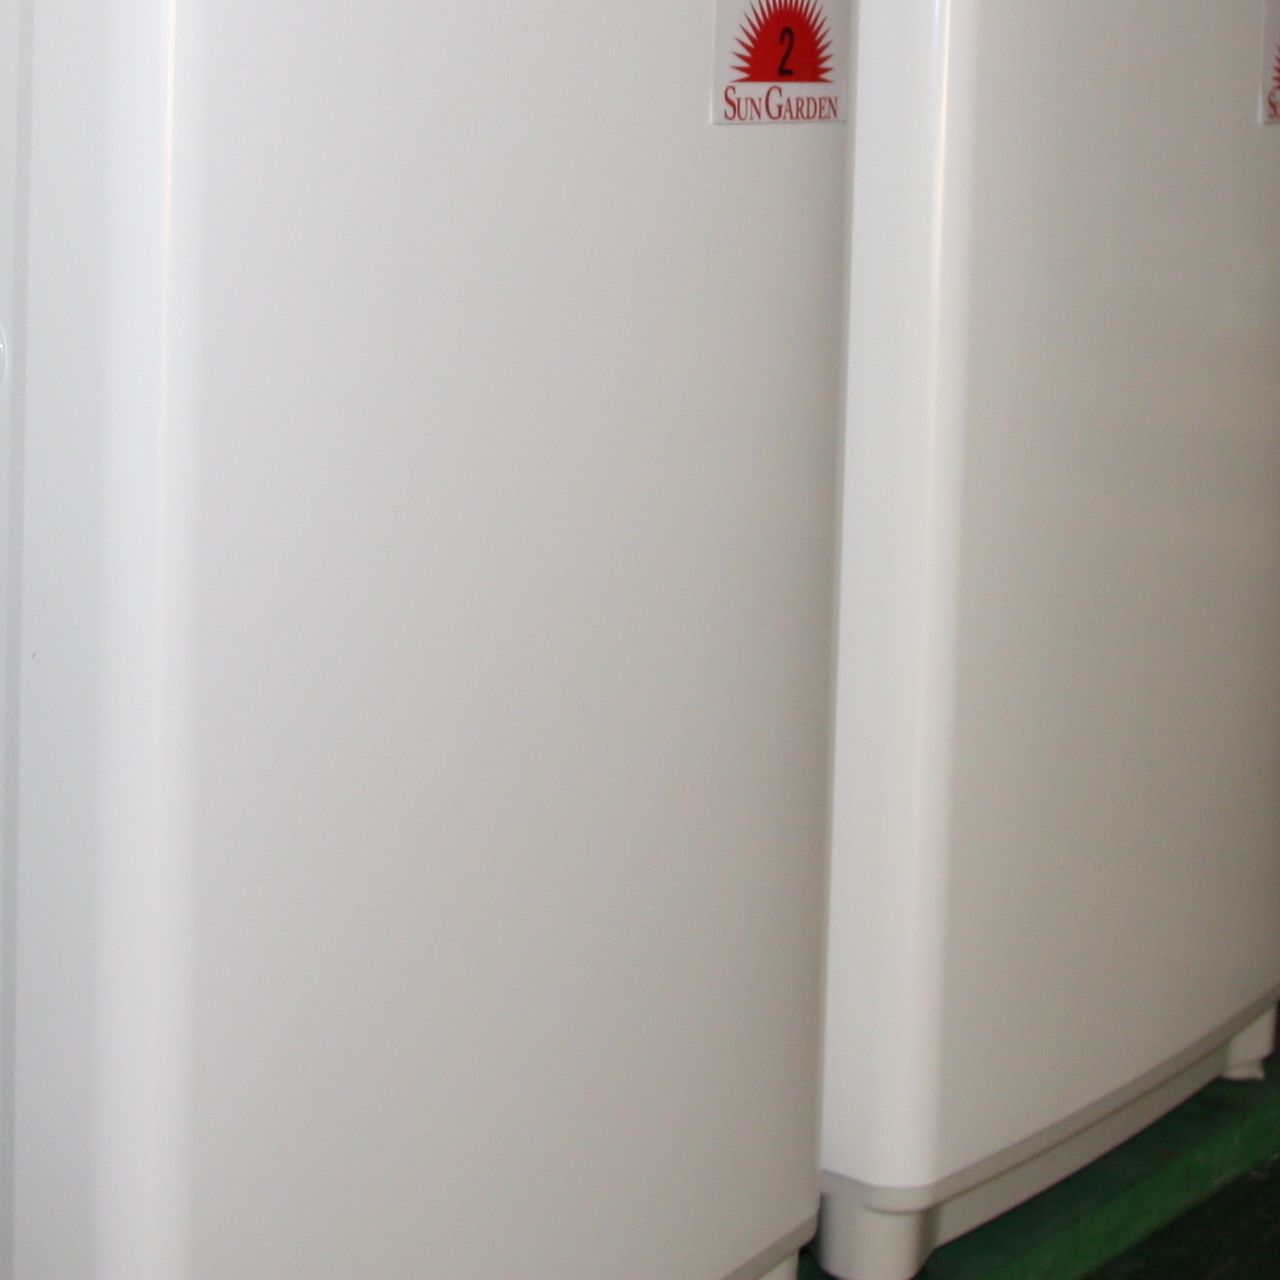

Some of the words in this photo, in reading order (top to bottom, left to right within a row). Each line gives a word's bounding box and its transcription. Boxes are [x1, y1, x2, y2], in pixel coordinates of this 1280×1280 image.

[778, 26, 795, 76] 2
[724, 85, 762, 120] SUN
[765, 85, 838, 120] GARDEN
